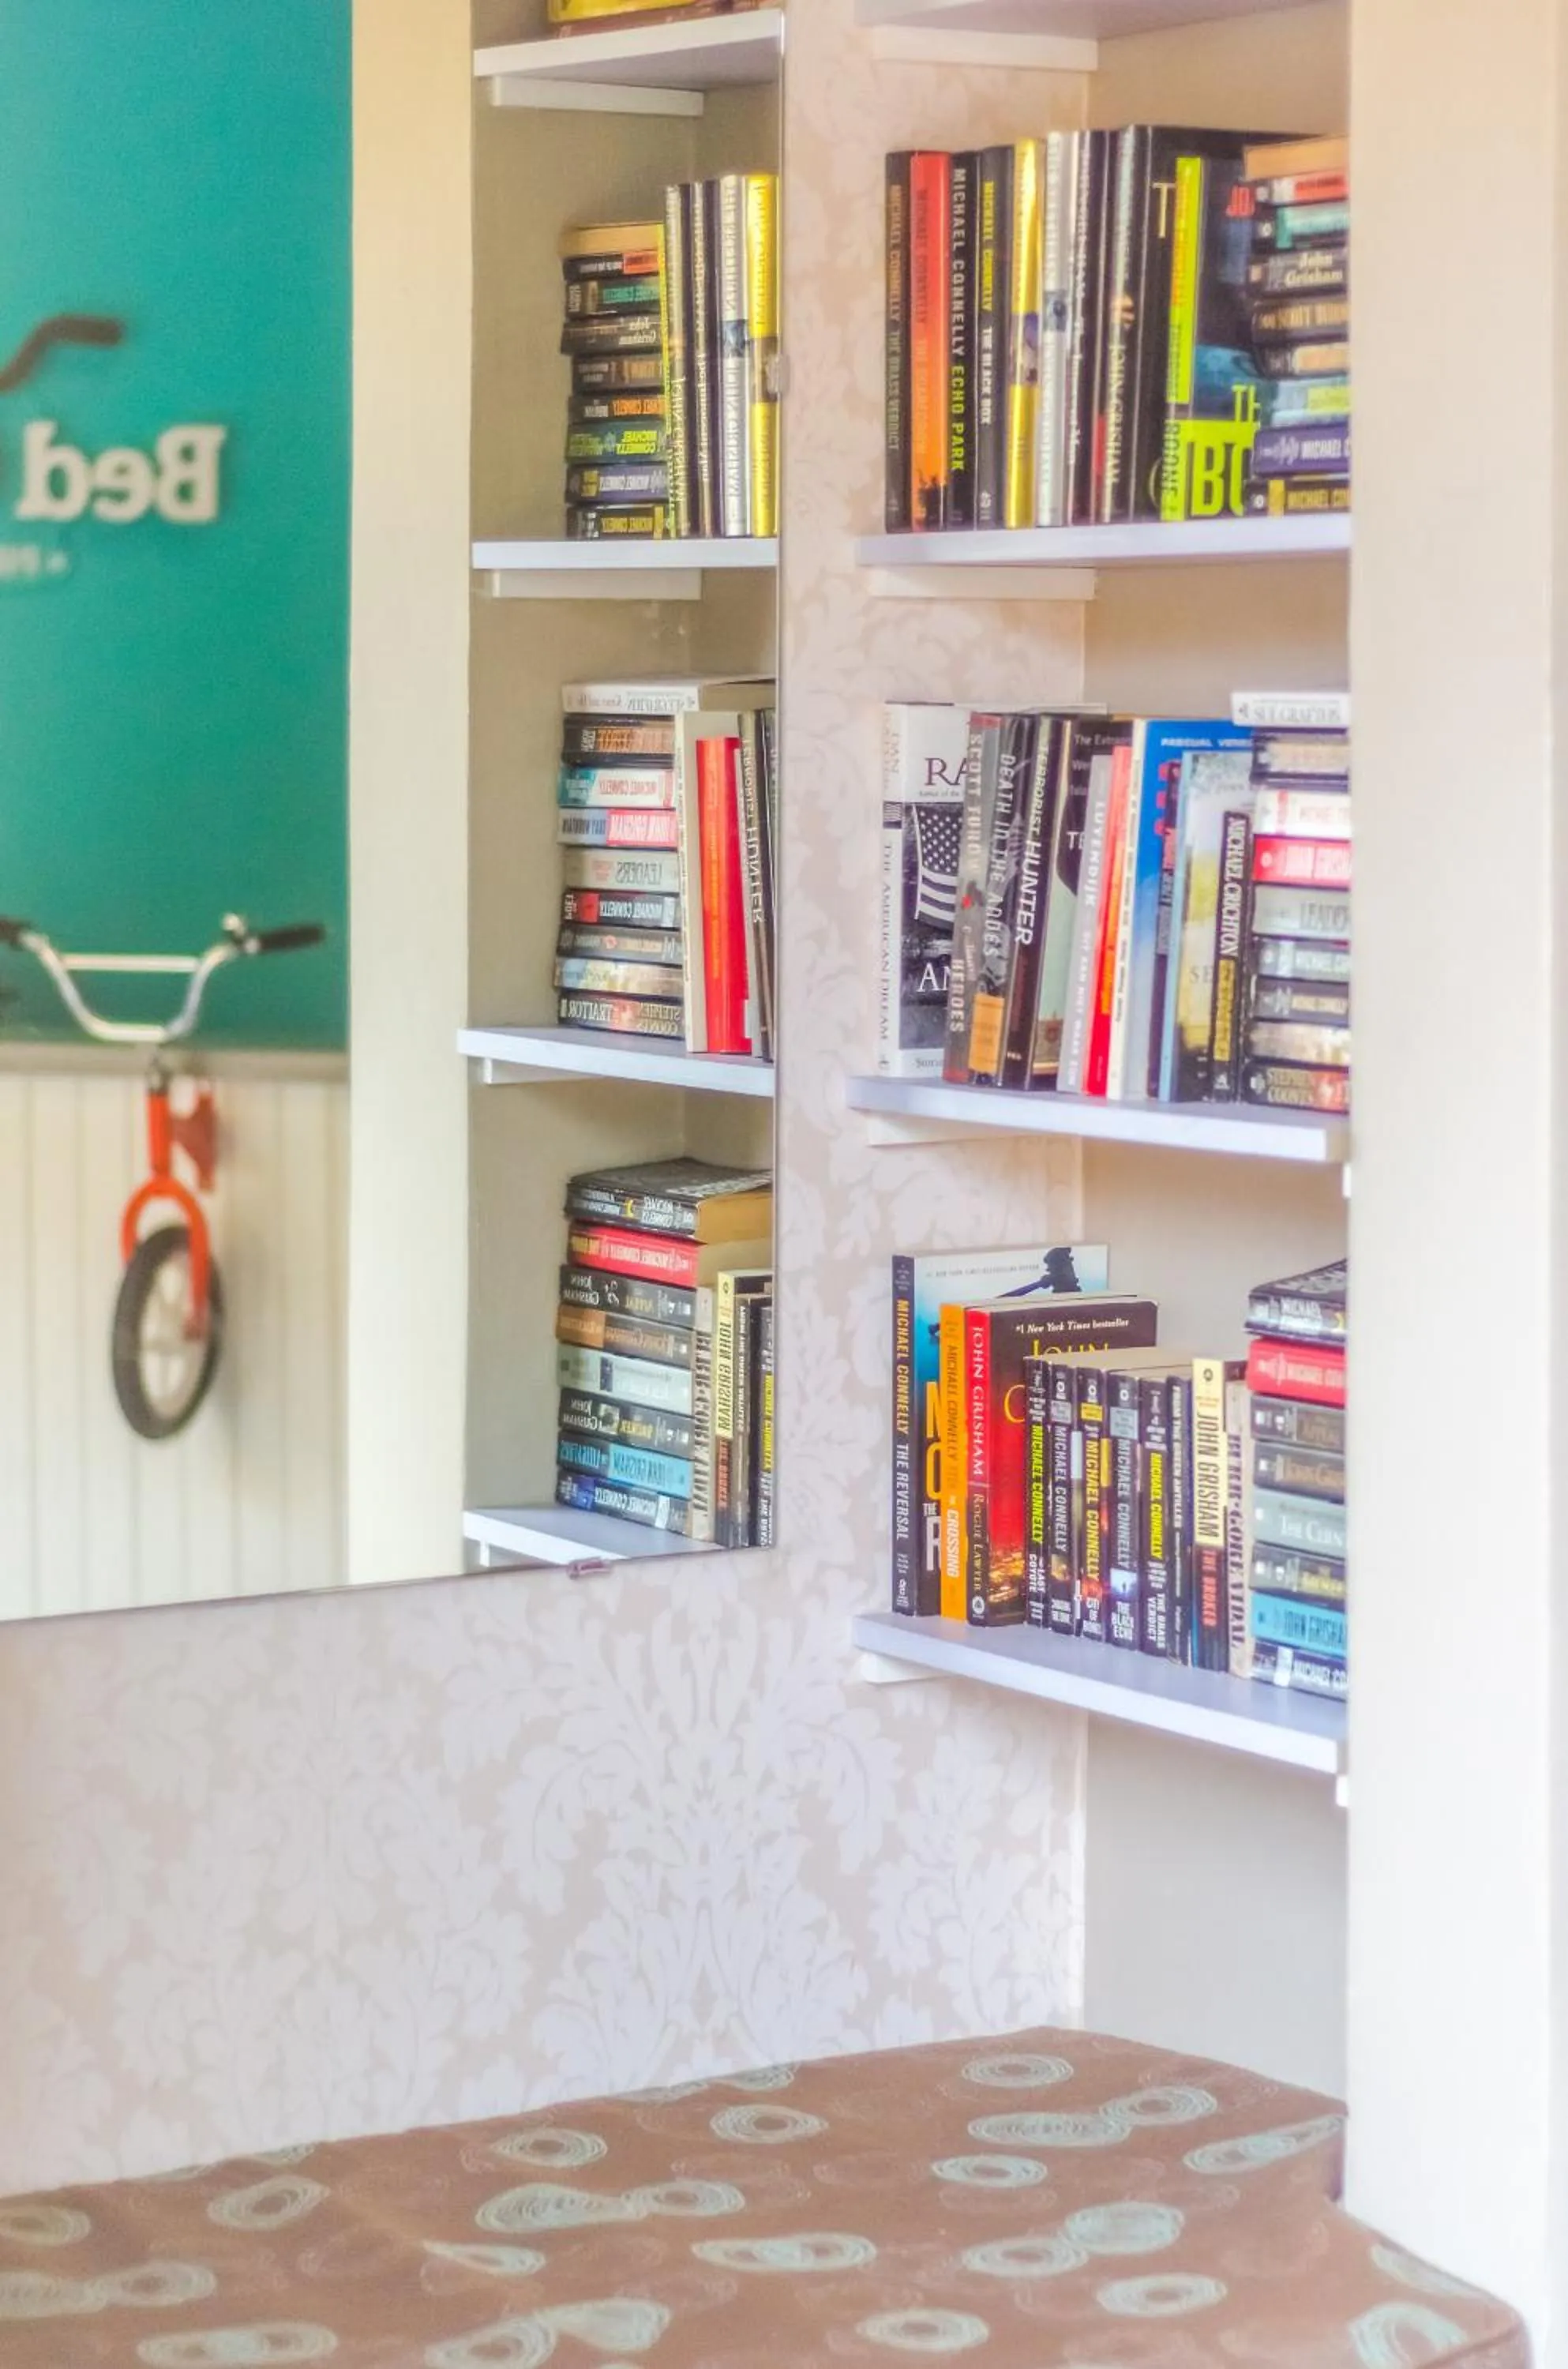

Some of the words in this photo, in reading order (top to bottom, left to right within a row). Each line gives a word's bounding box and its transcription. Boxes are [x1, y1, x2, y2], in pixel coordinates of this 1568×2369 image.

[890, 184, 902, 247] MICHAEL
[952, 168, 966, 251] MICHAEL
[982, 181, 995, 240] MICHAEL
[889, 250, 901, 321] CONNELLY
[981, 249, 993, 312] CONNELLY
[1284, 268, 1343, 288] Grisham
[1300, 252, 1334, 268] John
[951, 258, 965, 356] CONNELLY
[981, 326, 992, 349] THE
[951, 364, 965, 415] ECHO
[981, 354, 992, 395] BLACK
[1109, 344, 1126, 392] JOHN
[980, 397, 992, 425] BOX
[951, 422, 965, 471] PARK
[1107, 400, 1123, 483] GRISHAM
[1302, 437, 1341, 460] MICHAEL
[1281, 704, 1341, 723] GRAFTON
[969, 734, 981, 796] SCOTT
[1075, 735, 1093, 745] The
[996, 753, 1016, 814] DEATH
[1029, 745, 1049, 836] TERRORIST
[967, 806, 981, 870] TUROW
[990, 842, 1009, 882] THE
[1225, 816, 1246, 880] MICHAEL
[1015, 839, 1041, 946] HUNTER
[880, 881, 892, 969] AMERICAN
[1220, 880, 1243, 957] CRICHTON
[879, 978, 891, 1041] DREAM
[951, 958, 964, 1033] HEROES
[897, 1299, 910, 1360] MICHAEL
[1016, 1324, 1024, 1334] #1
[1027, 1324, 1044, 1334] New
[1046, 1321, 1064, 1332] York
[1067, 1320, 1090, 1331] Times
[1093, 1318, 1129, 1329] bestseller
[1281, 1297, 1321, 1317] MICHAEL
[947, 1345, 958, 1395] MICHAEL
[973, 1327, 985, 1378] JOHN
[896, 1365, 909, 1434] CONNELLY
[1172, 1385, 1182, 1418] FROM
[947, 1400, 958, 1459] CONNELLY
[972, 1385, 985, 1476] GRISHAM
[1031, 1425, 1043, 1479] MICHAEL
[1056, 1425, 1067, 1485] MICHAEL
[1172, 1421, 1182, 1441] THE
[1196, 1411, 1219, 1457] JOHN
[896, 1443, 910, 1470] THE
[1086, 1439, 1100, 1504] MICHAEL
[1117, 1439, 1132, 1498] MICHAEL
[1150, 1452, 1162, 1500] MICHAEL
[1173, 1442, 1182, 1477] GREEN
[895, 1474, 910, 1541] REVERSAL
[922, 1502, 938, 1517] THE
[972, 1493, 985, 1538] ROGUE
[1031, 1482, 1043, 1545] CONNELLY
[1055, 1485, 1068, 1552] CONNELLY
[1173, 1478, 1183, 1529] ANTILLES
[1197, 1462, 1220, 1538] GRISHAM
[946, 1509, 959, 1579] CROSSING
[1085, 1508, 1100, 1580] CONNELLY
[1116, 1503, 1131, 1569] CONNELLY
[1150, 1503, 1163, 1560] CONNELLY
[1281, 1515, 1302, 1537] THE
[972, 1544, 985, 1591] LAWYER
[1029, 1553, 1037, 1594] COYOTE
[1037, 1567, 1045, 1594] LAST
[1202, 1549, 1217, 1571] THE
[1147, 1596, 1157, 1643] VERDICT
[1157, 1594, 1165, 1612] THE
[1202, 1575, 1217, 1627] BROKER
[1285, 1608, 1306, 1637] JOHN
[1157, 1616, 1166, 1649] BRASS
[1292, 1660, 1331, 1688] MICHAEL
